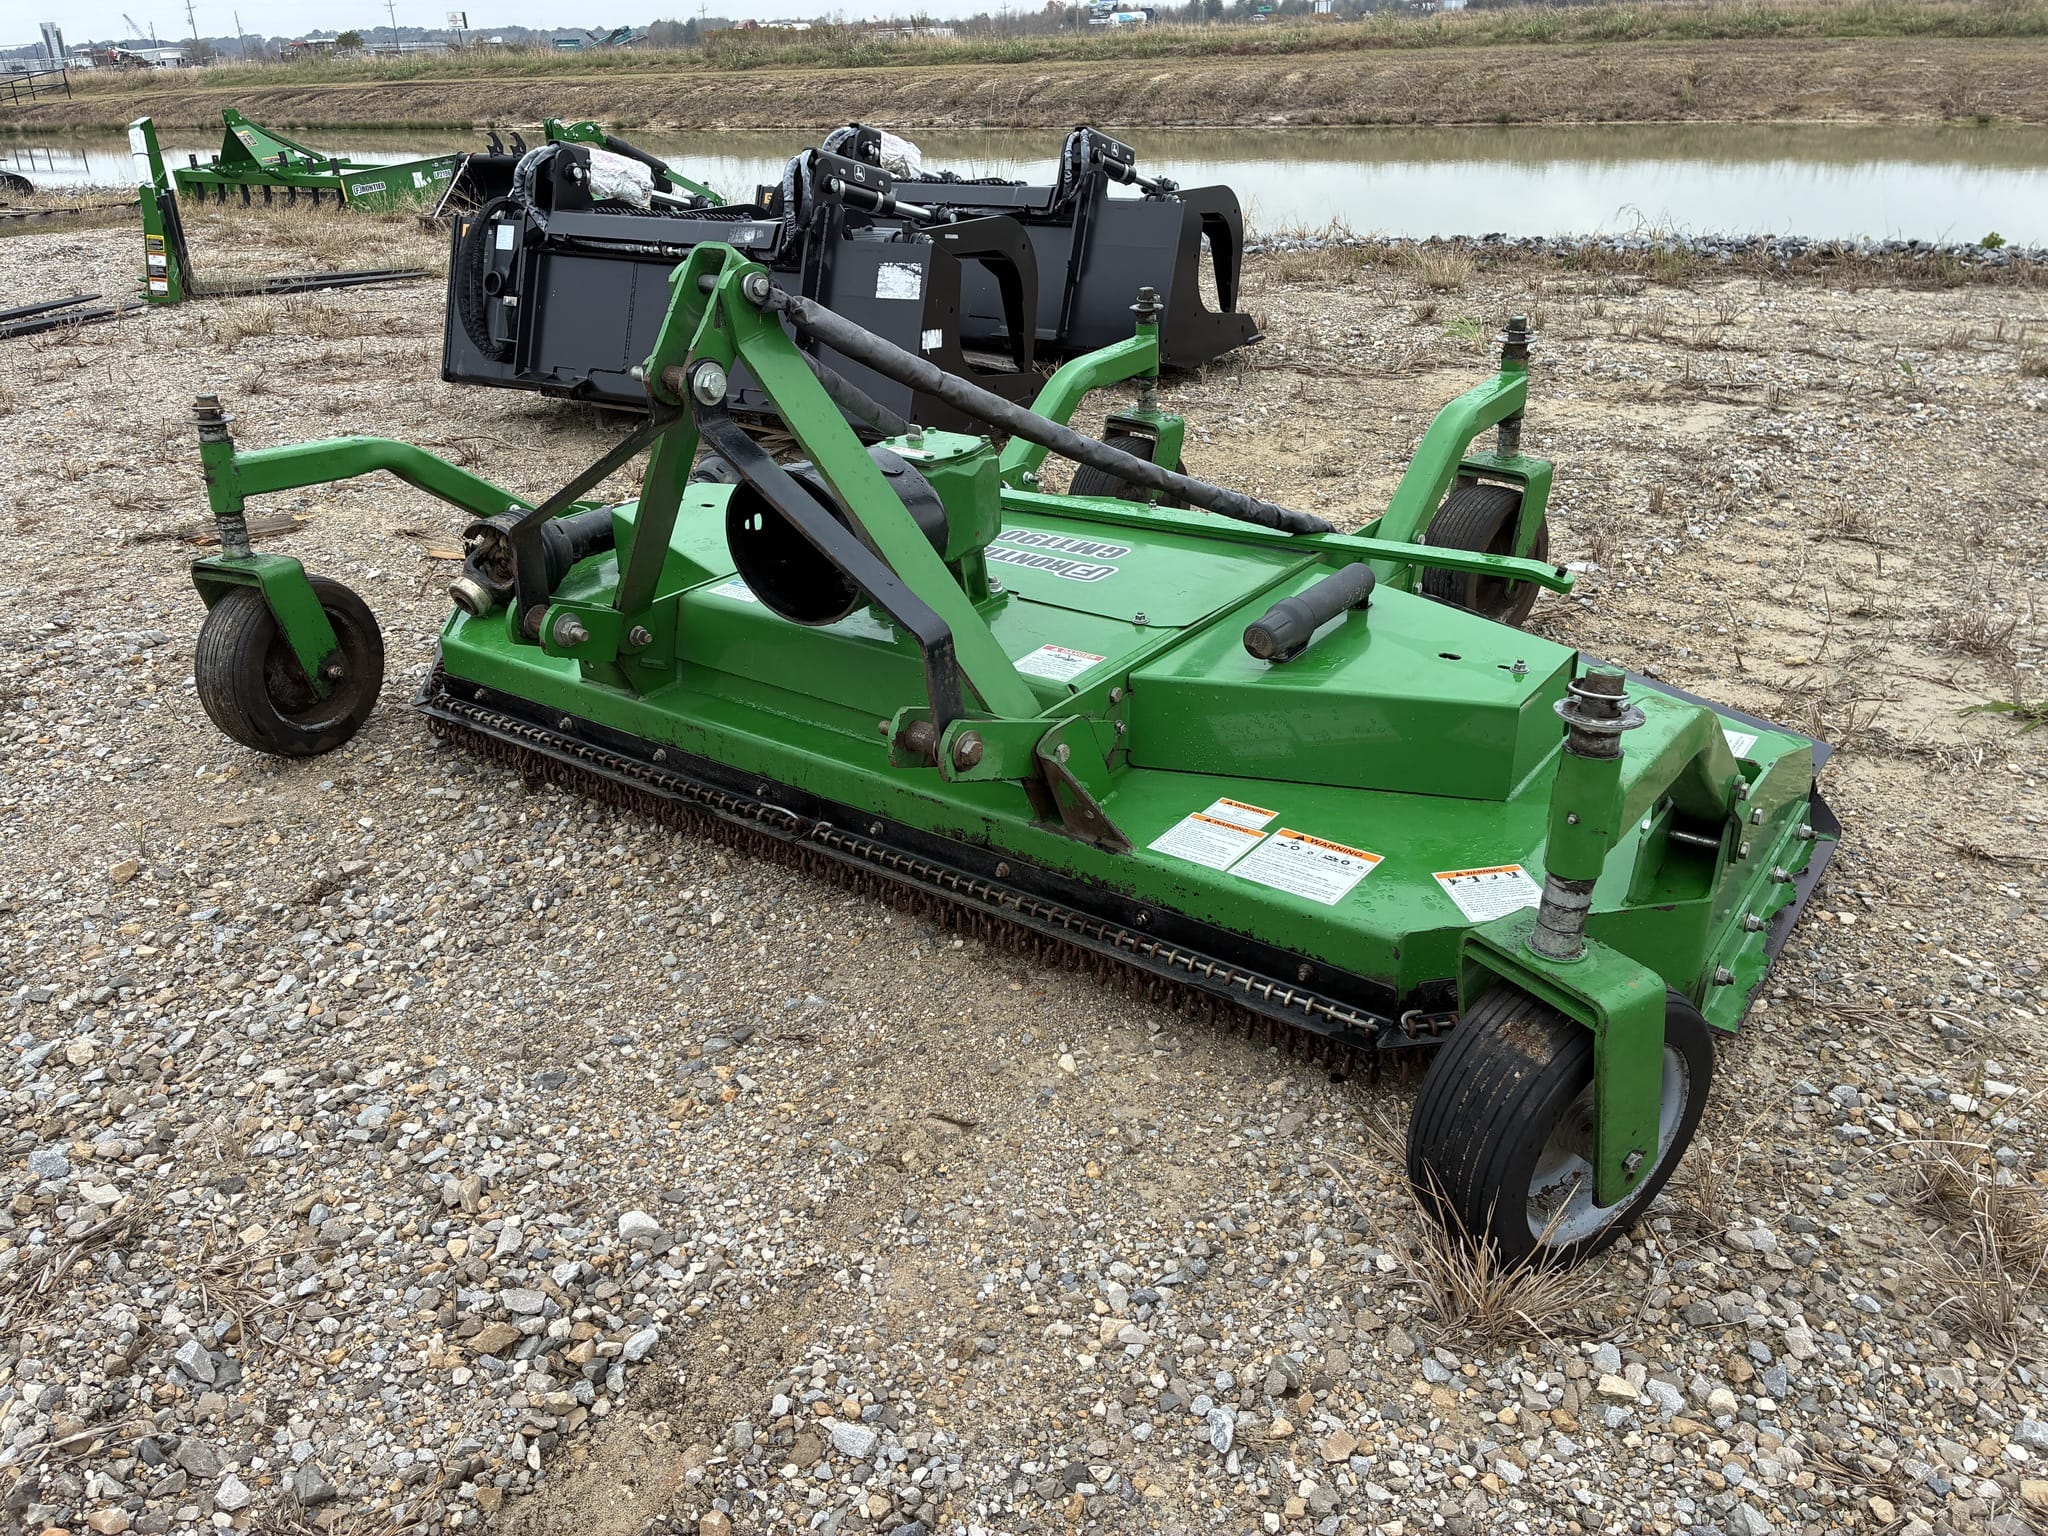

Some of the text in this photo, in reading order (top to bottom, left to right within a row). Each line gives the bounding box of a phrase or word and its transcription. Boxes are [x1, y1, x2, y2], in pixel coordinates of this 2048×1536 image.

[353, 182, 386, 196] FRONTIER
[998, 529, 1130, 559] GM1190
[985, 546, 1117, 581] FRONTI
[1234, 801, 1270, 816] WARNING
[1213, 819, 1249, 834] WARNING
[1309, 837, 1364, 859] WARNING
[1465, 868, 1504, 876] WARNING
